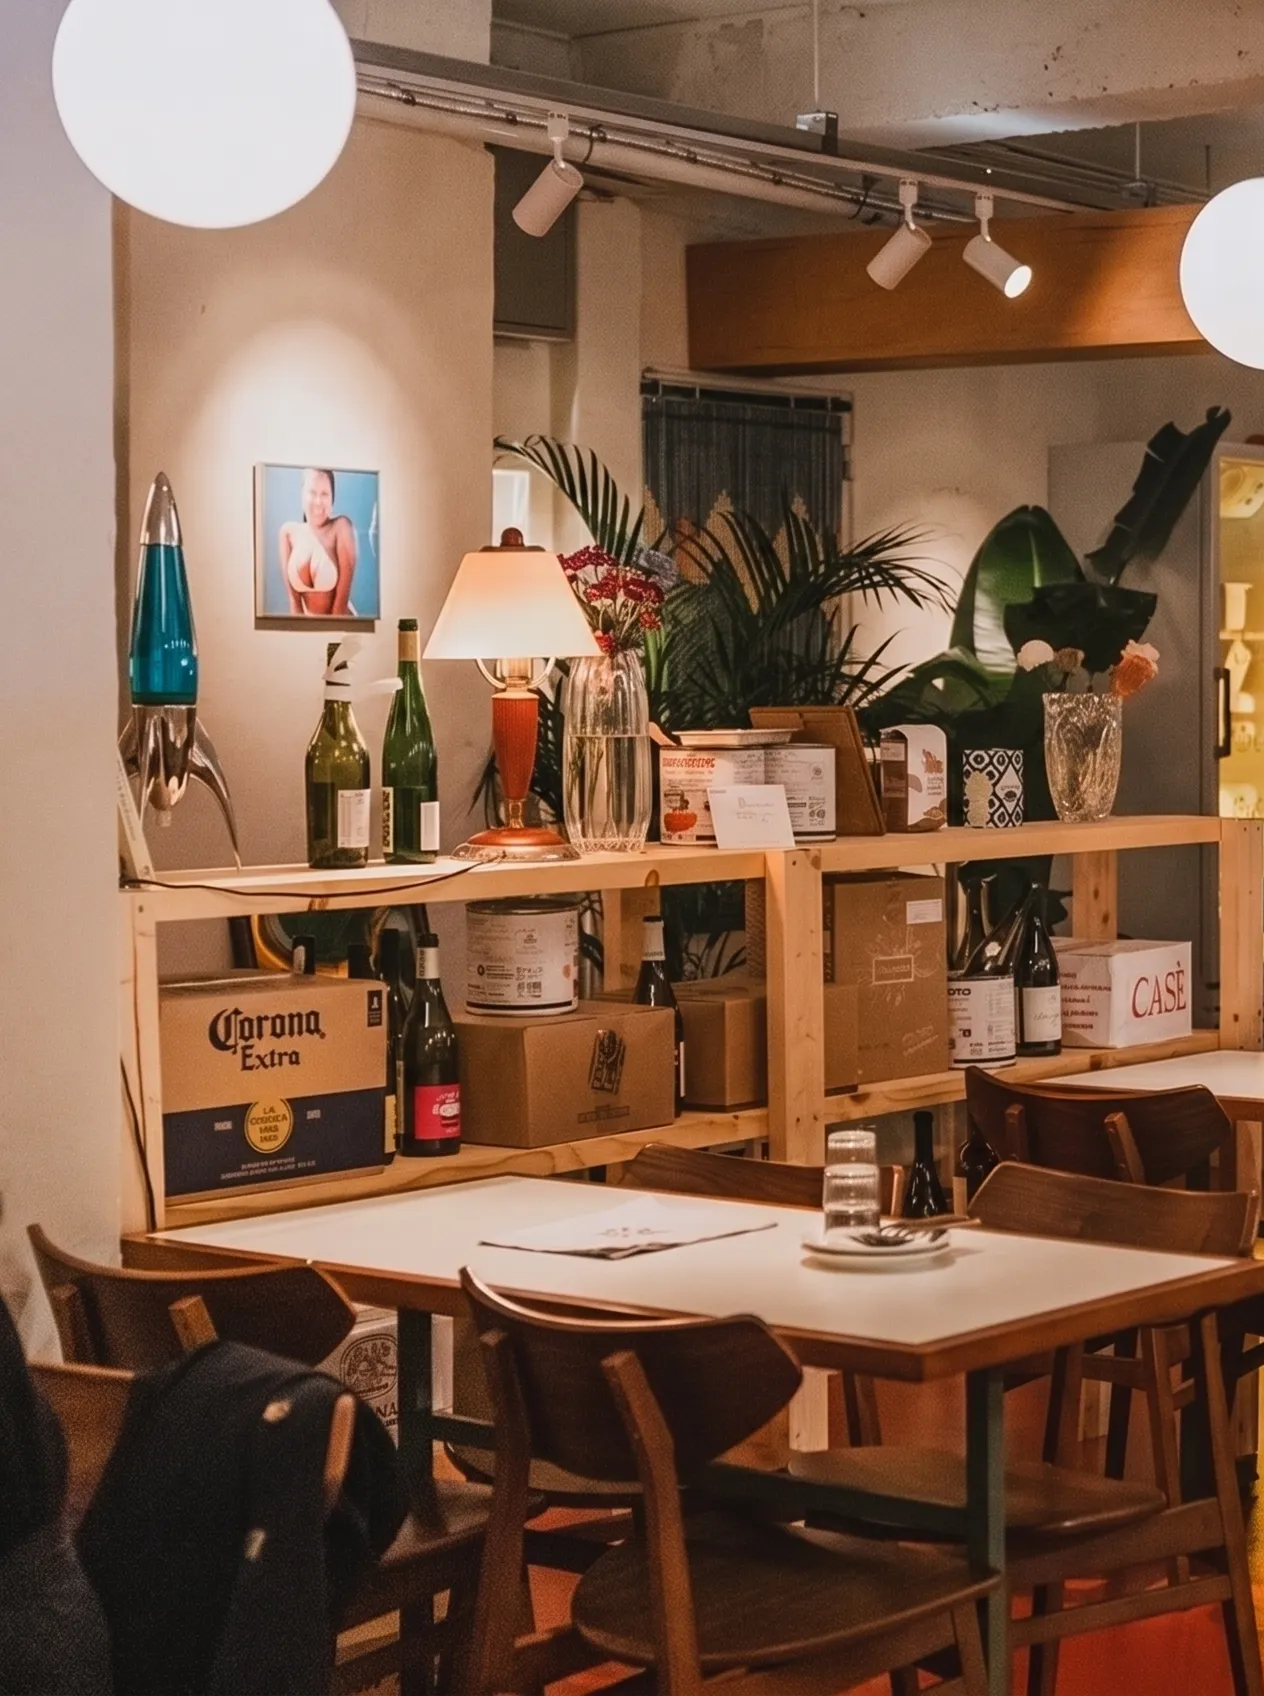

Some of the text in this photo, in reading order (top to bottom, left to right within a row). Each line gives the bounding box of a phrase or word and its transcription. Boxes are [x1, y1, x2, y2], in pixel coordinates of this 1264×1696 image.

[1131, 960, 1187, 1019] CASÈ
[208, 1007, 322, 1055] Corona
[240, 1044, 301, 1072] Extra
